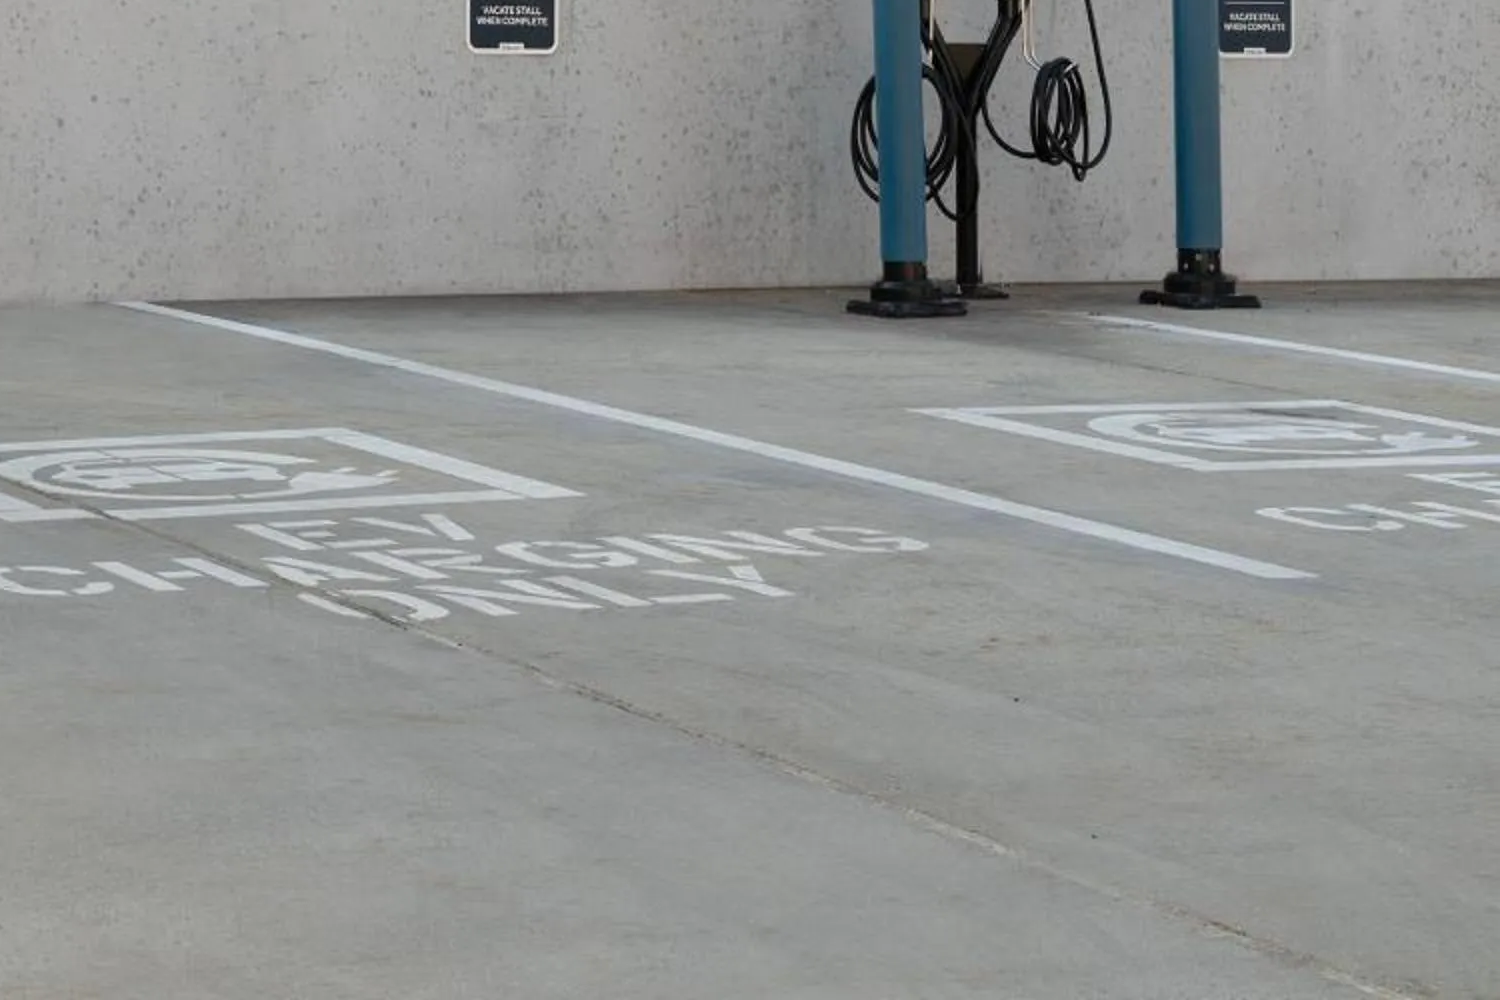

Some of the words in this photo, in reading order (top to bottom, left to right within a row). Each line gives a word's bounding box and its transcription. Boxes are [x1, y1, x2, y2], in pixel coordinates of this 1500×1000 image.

[476, 16, 500, 25] WHEN
[502, 16, 548, 26] COMPLETE
[483, 5, 514, 14] VACATE
[516, 5, 542, 15] STALL
[233, 513, 475, 551] EV
[294, 566, 798, 622] ONLY
